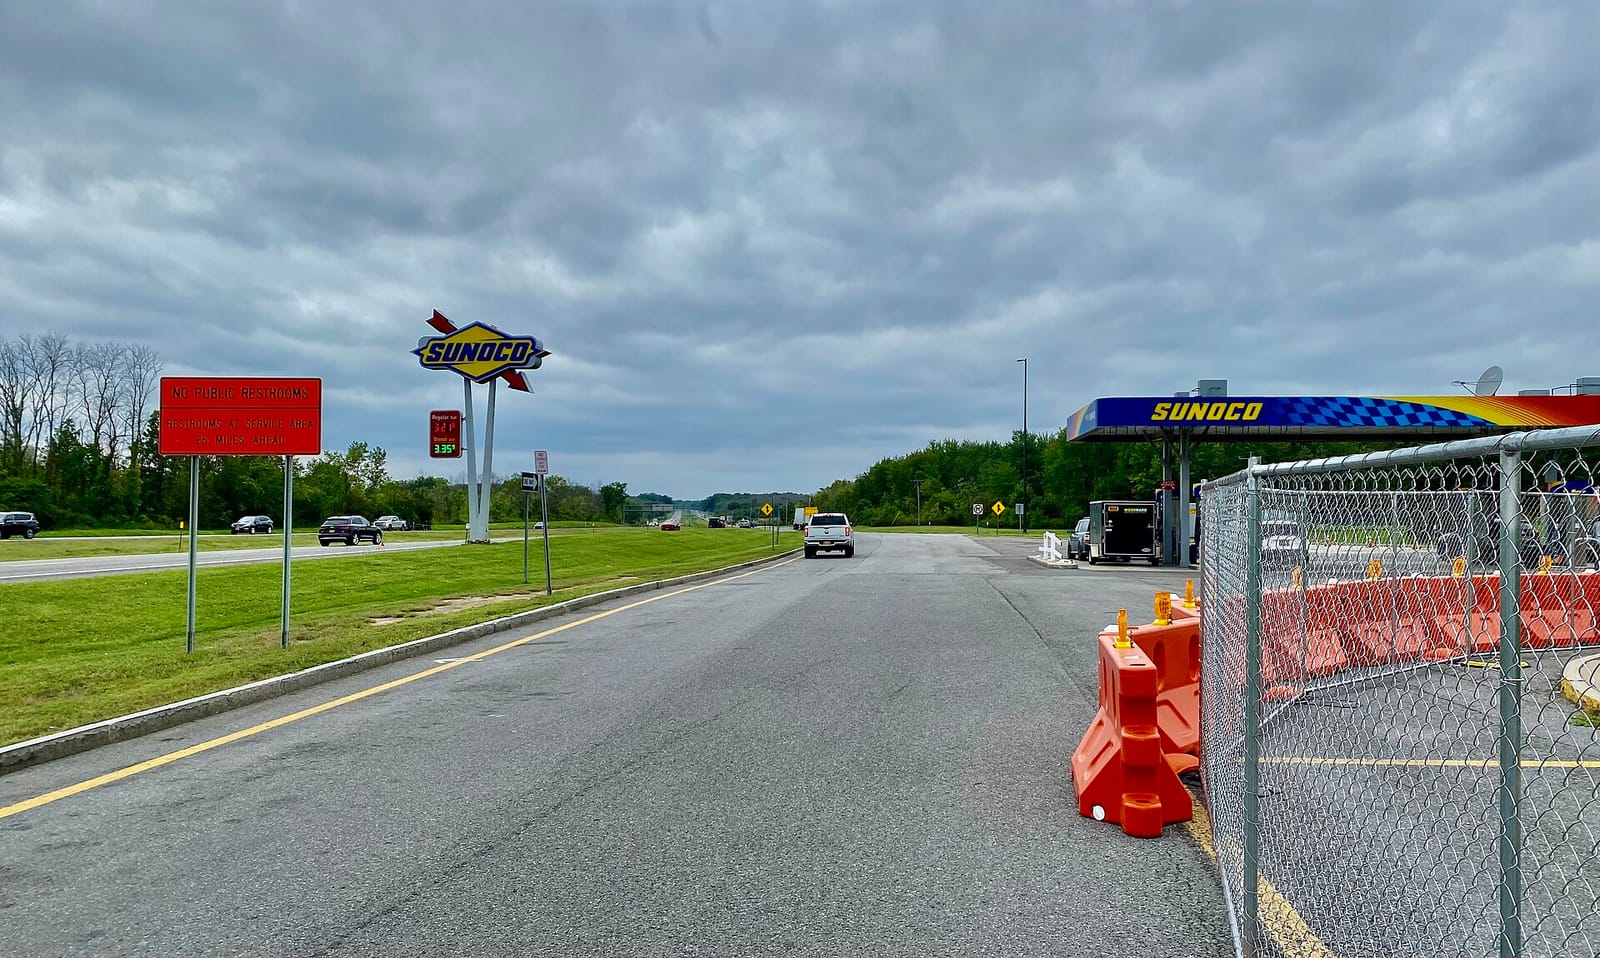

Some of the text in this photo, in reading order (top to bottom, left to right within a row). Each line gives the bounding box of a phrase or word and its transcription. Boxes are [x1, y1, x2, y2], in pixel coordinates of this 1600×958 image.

[425, 342, 530, 362] SUNOCO
[172, 387, 309, 400] NO PUBLIC RESTROOMS
[1150, 402, 1264, 421] SUNOCO
[167, 419, 313, 429] RESTROOMS AT SERVICE AREA
[215, 435, 245, 445] MILES
[253, 435, 285, 445] AHEAD
